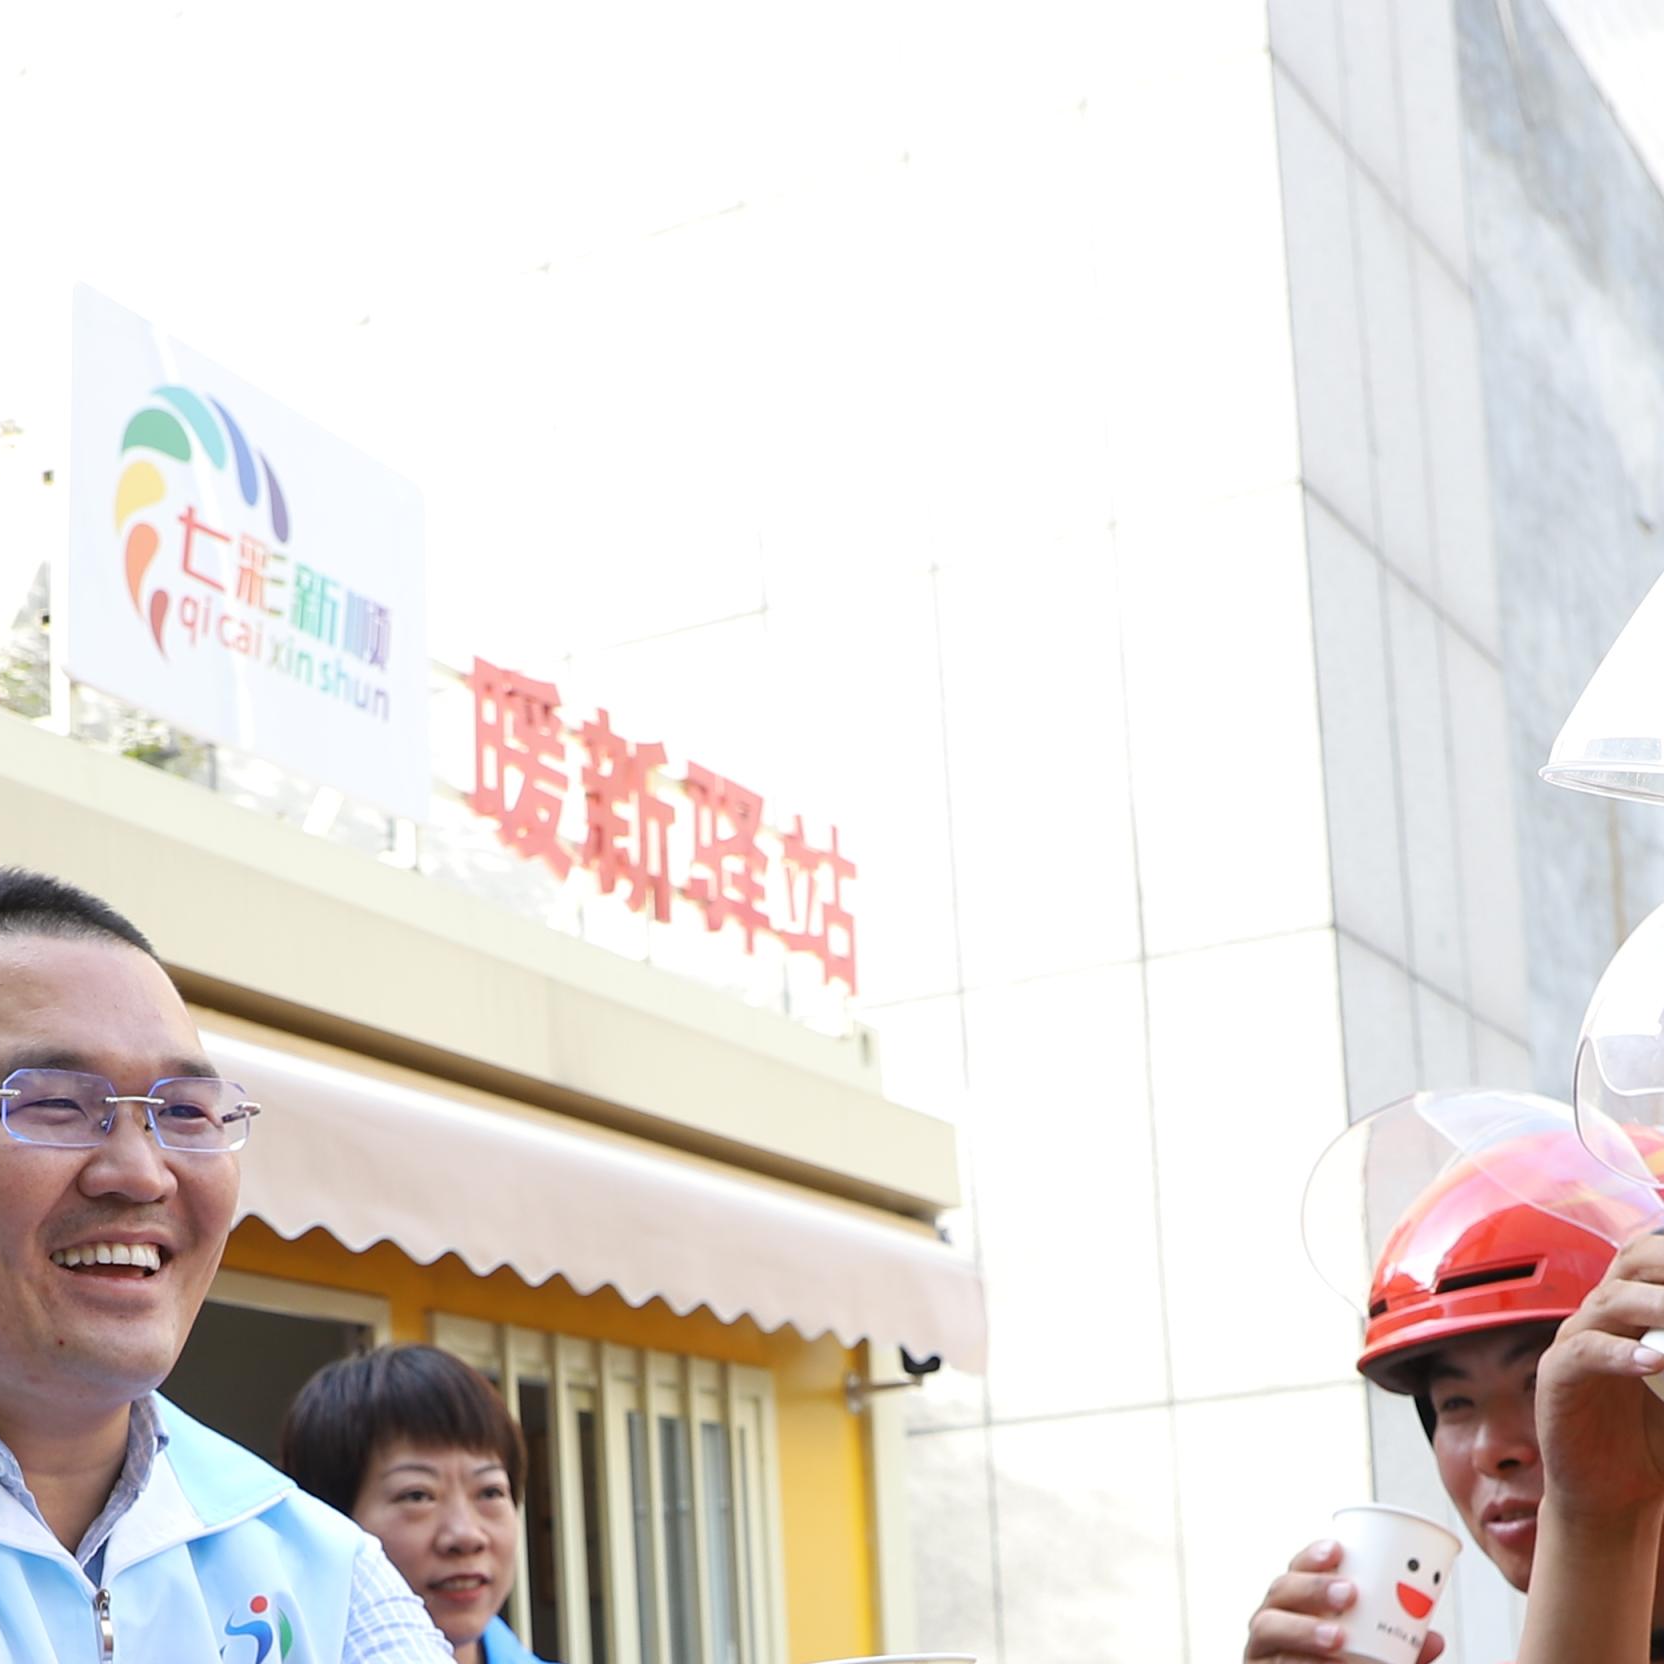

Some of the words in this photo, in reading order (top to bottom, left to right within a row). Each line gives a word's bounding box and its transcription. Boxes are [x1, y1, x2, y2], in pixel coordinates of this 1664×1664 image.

[177, 504, 392, 673] 七彩新顺
[472, 656, 857, 996] 暖新驿站
